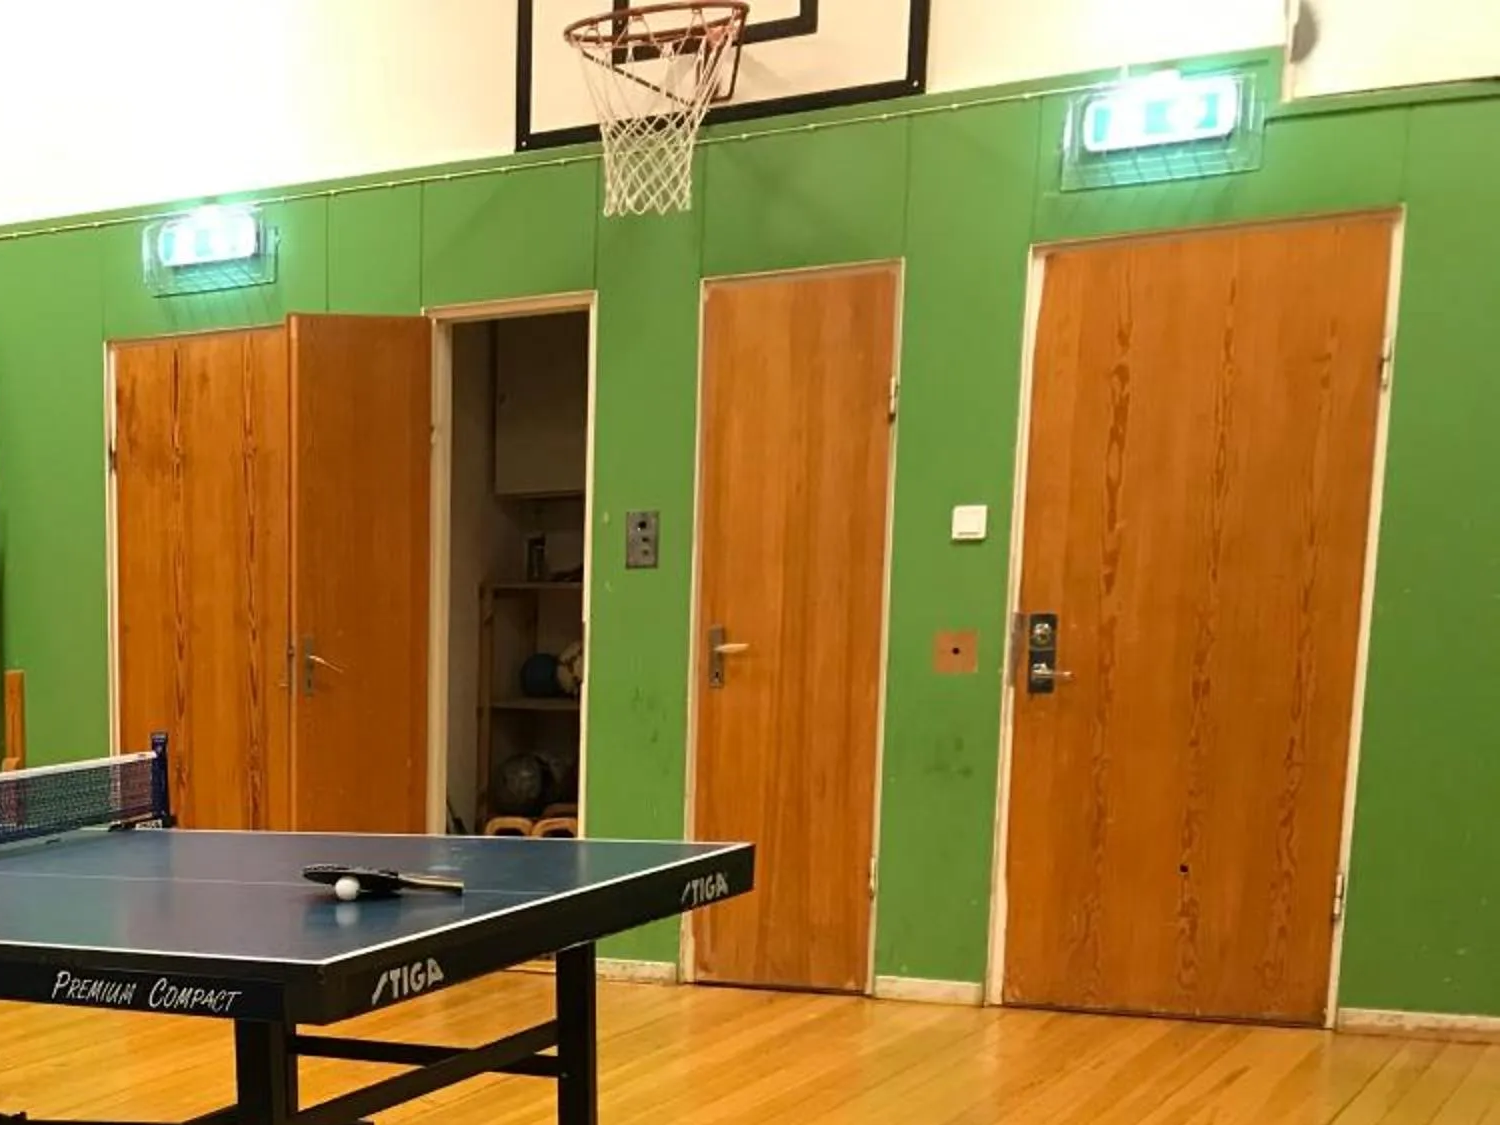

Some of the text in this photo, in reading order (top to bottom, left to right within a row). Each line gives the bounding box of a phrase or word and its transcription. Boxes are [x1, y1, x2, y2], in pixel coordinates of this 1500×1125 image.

[681, 872, 730, 906] STIGA
[51, 970, 242, 1013] PREMIUM COMPACT
[371, 957, 445, 1006] STIGA
